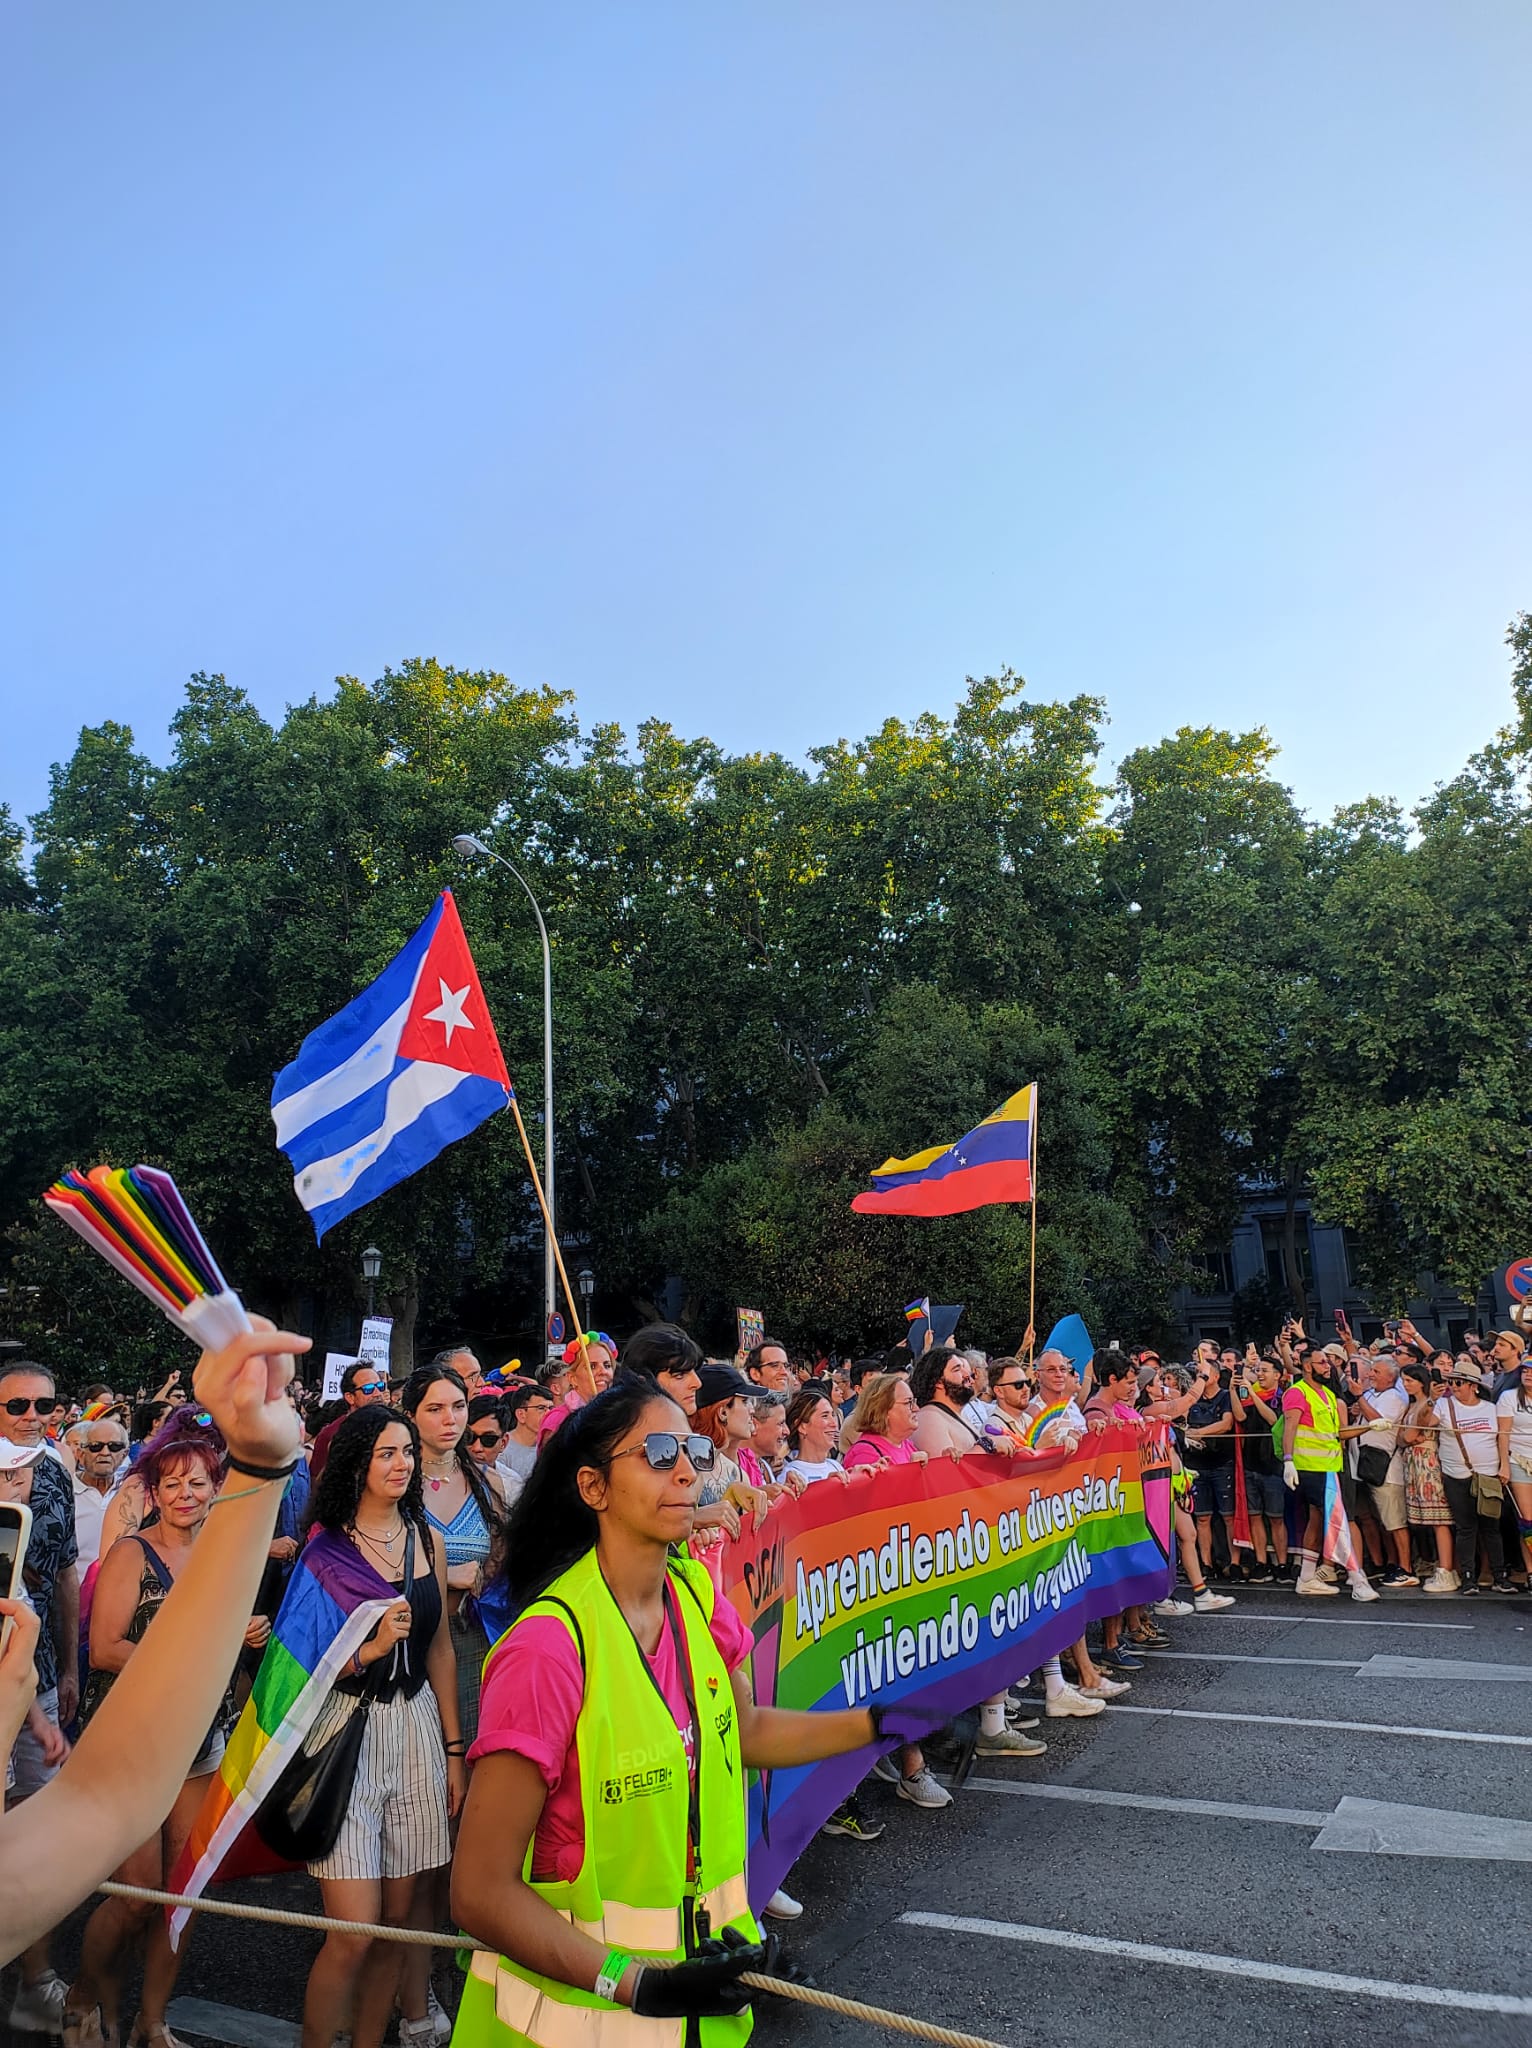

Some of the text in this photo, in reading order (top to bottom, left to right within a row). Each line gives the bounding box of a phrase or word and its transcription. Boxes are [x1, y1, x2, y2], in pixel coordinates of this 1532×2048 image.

[796, 1509, 990, 1643] Aprendiendo
[998, 1507, 1023, 1556] en
[839, 1593, 979, 1709] viviendo
[990, 1580, 1030, 1638] con
[624, 1766, 673, 1791] FELGTBI+
